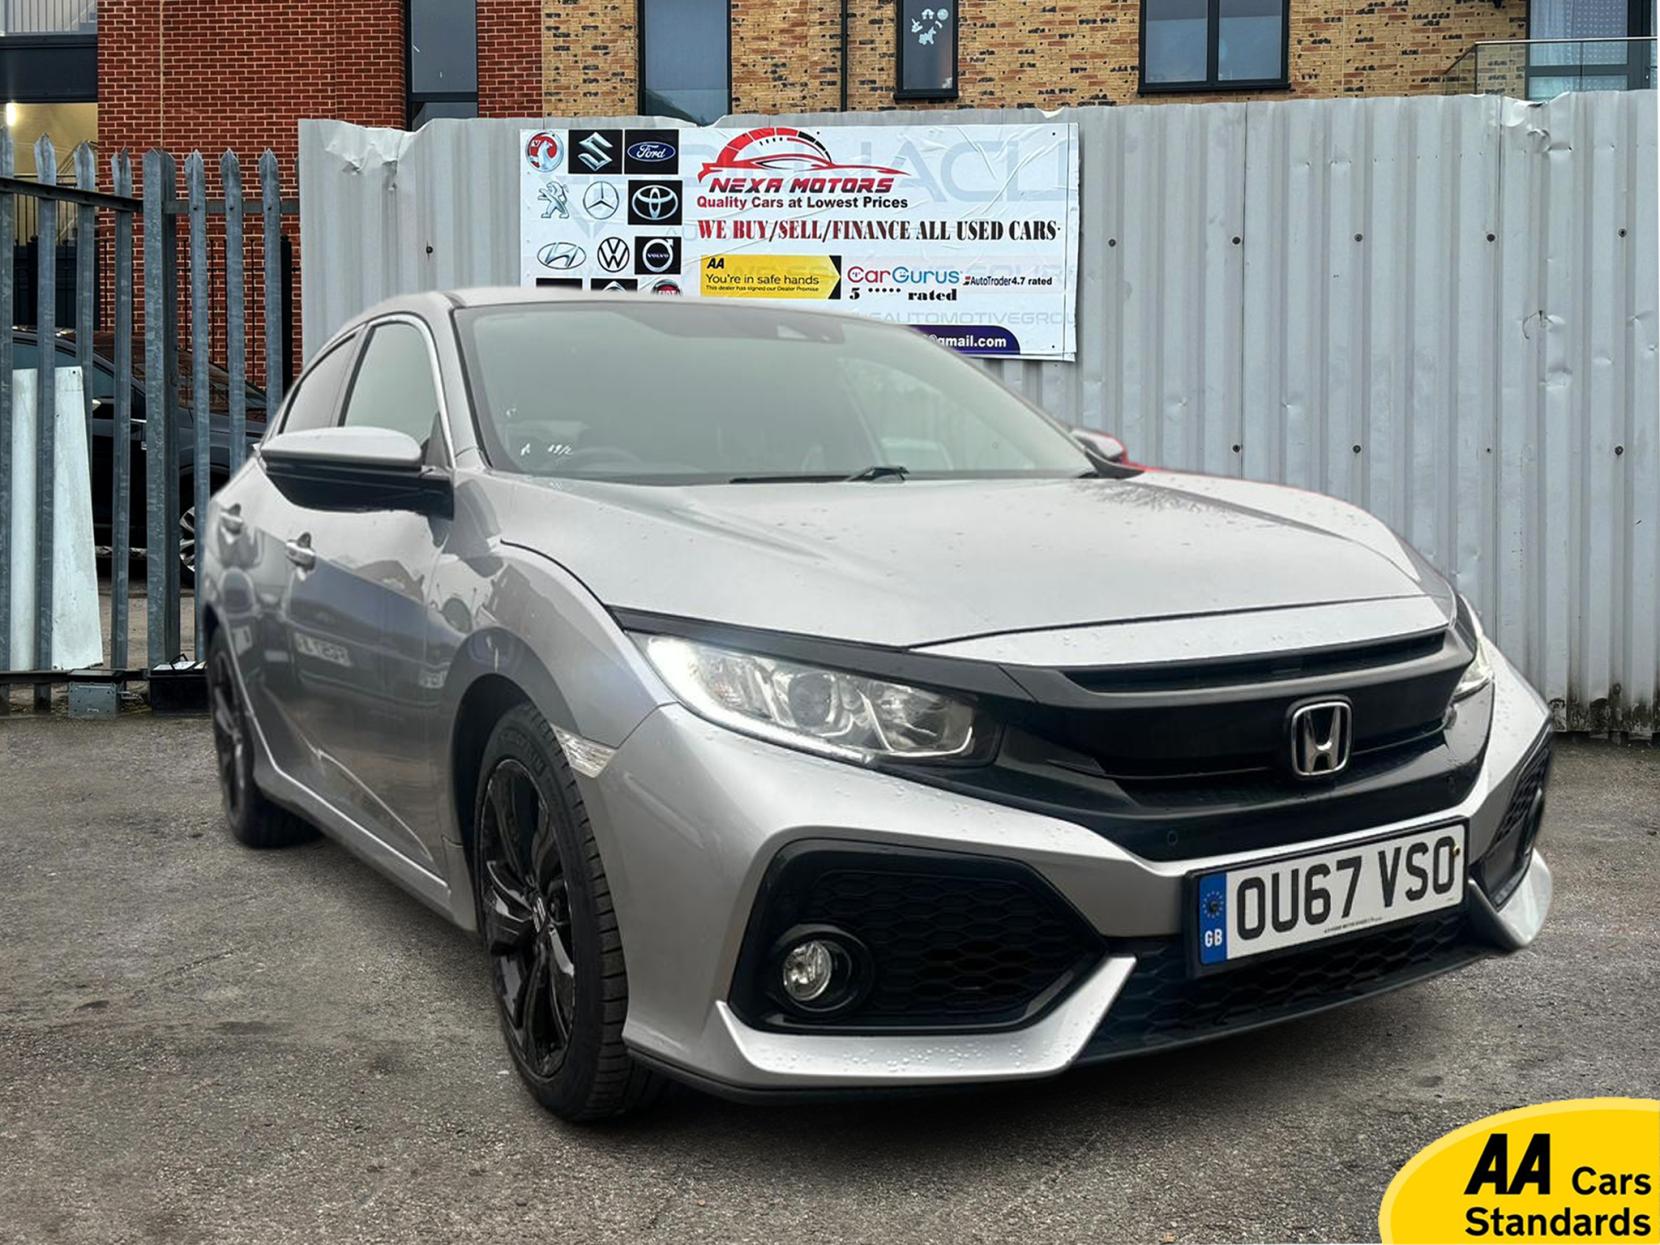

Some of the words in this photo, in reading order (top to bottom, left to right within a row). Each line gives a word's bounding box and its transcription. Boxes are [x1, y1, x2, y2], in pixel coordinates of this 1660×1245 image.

[636, 144, 666, 158] Ford
[708, 177, 783, 194] NEXA
[789, 177, 895, 194] MOTORS
[696, 195, 747, 210] Quality
[751, 196, 784, 208] Cars
[788, 196, 803, 208] at
[807, 196, 859, 208] Lowest
[862, 196, 908, 208] Prices
[697, 219, 727, 240] WE
[732, 219, 911, 243] BUY/SELL/FINANCE
[916, 220, 951, 241] ALL
[956, 220, 1004, 241] USED
[1008, 220, 1057, 241] CARS
[706, 257, 725, 269] AA
[706, 273, 741, 284] You're
[744, 273, 754, 284] in
[757, 274, 781, 285] safe
[784, 275, 820, 285] hands
[847, 266, 960, 284] CarGurus
[1028, 276, 1053, 286] rated
[849, 287, 861, 300] 5
[907, 288, 957, 301] rated
[1236, 855, 1362, 941] OU67
[1377, 835, 1456, 908] VSO
[1204, 928, 1223, 948] GB
